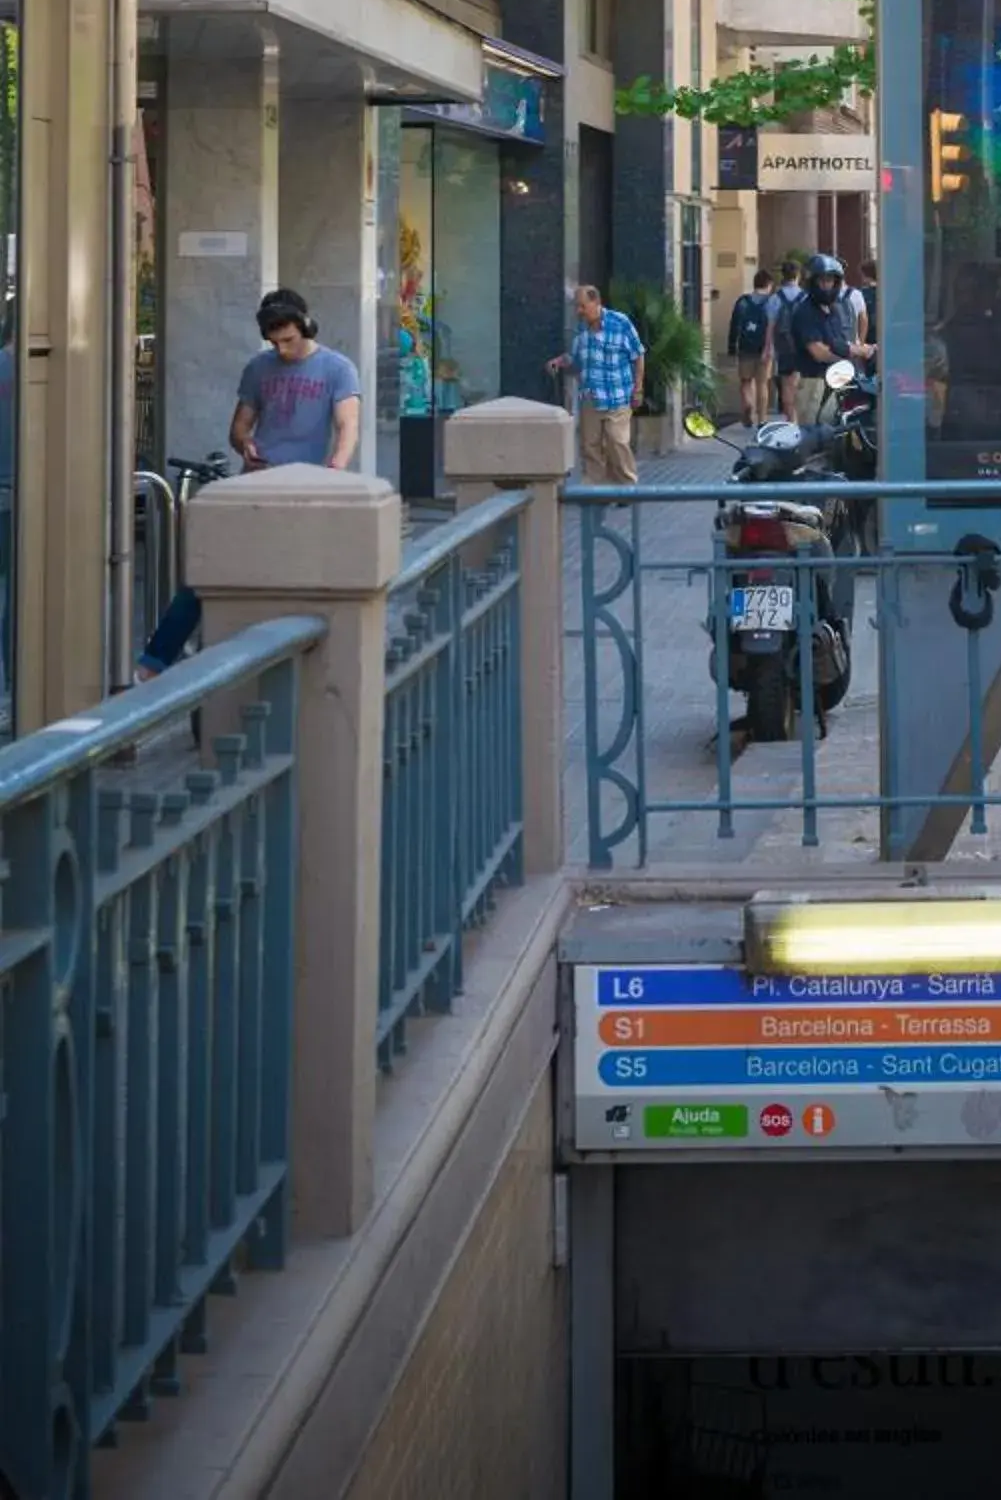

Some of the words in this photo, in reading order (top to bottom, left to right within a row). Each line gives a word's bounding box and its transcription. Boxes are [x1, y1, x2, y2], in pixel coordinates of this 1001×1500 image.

[762, 157, 874, 171] APARTHOTEL
[613, 976, 645, 998] L6
[789, 975, 905, 999] Catalunya
[927, 972, 997, 995] Sarrià
[615, 1016, 644, 1039] S1
[761, 1015, 874, 1037] Barcelona
[896, 1013, 992, 1035] Terrassa
[616, 1056, 648, 1078] S5
[746, 1054, 859, 1077] Barcelona
[882, 1053, 932, 1076] Sant
[672, 1107, 720, 1124] Ajuda
[761, 1113, 791, 1128] SOS
